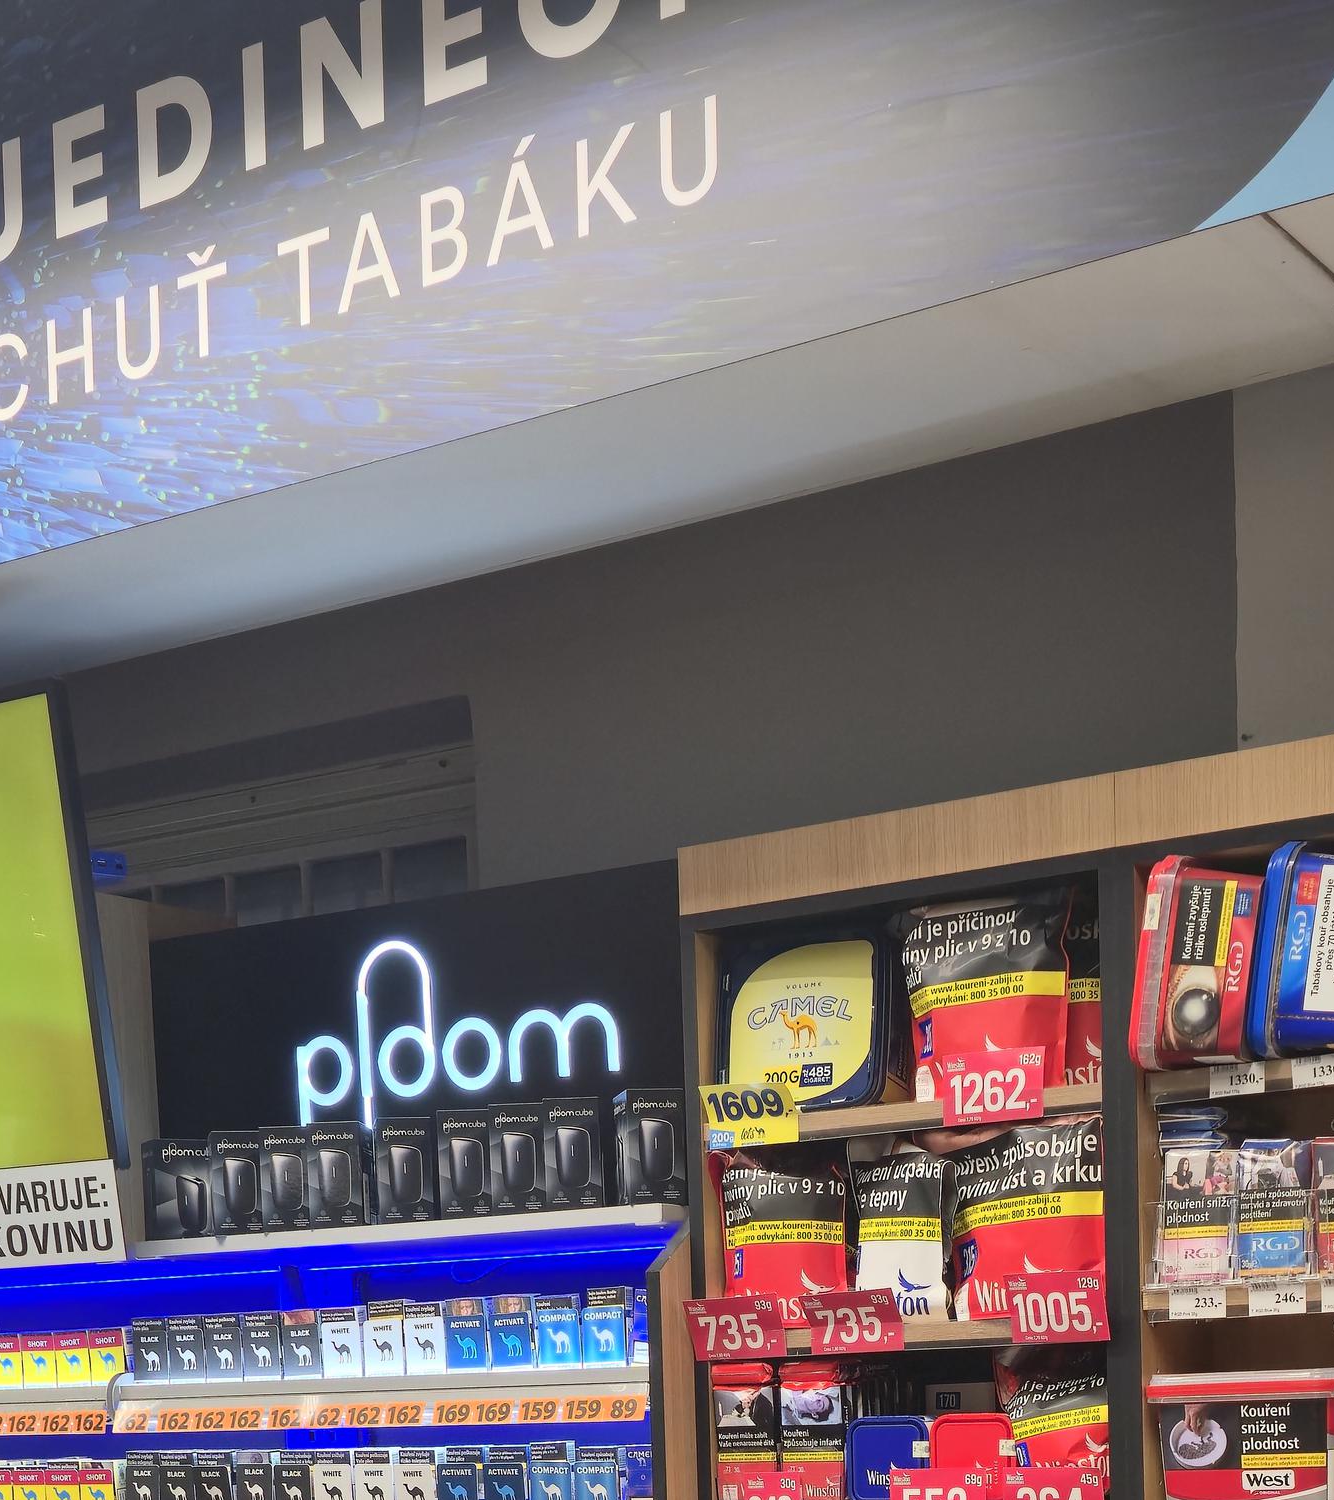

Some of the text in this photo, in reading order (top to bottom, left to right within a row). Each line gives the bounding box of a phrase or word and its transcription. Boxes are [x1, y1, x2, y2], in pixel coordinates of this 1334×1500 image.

[277, 94, 718, 326] TABÁKU
[934, 929, 1031, 962] plic 9 10
[930, 974, 1024, 995] www.koureni-zabiji.cz
[747, 995, 853, 1030] CAMEL
[297, 939, 623, 1126] ploom
[788, 1051, 813, 1059] 1913
[1018, 1053, 1041, 1066] 162g
[764, 1070, 799, 1085] 200G
[809, 1066, 831, 1078] 485
[1227, 1073, 1265, 1088] 1330,-
[949, 1067, 1038, 1116] 1262,-
[707, 1088, 794, 1123] 1609,-
[1002, 1133, 1097, 1171] způsobuje
[1052, 1159, 1102, 1183] krku
[869, 1188, 907, 1212] tepny
[1077, 1277, 1099, 1289] 129g
[1013, 1291, 1103, 1335] 1005,-
[450, 1319, 481, 1329] ACTIVATE
[698, 1312, 778, 1352] 735,-
[522, 1401, 556, 1421] 159
[1239, 1403, 1291, 1418] Kouření
[1241, 1420, 1287, 1436] snižuje
[1242, 1436, 1300, 1452] plodnost
[282, 1469, 302, 1478] BLACK
[780, 1479, 796, 1490] 30g
